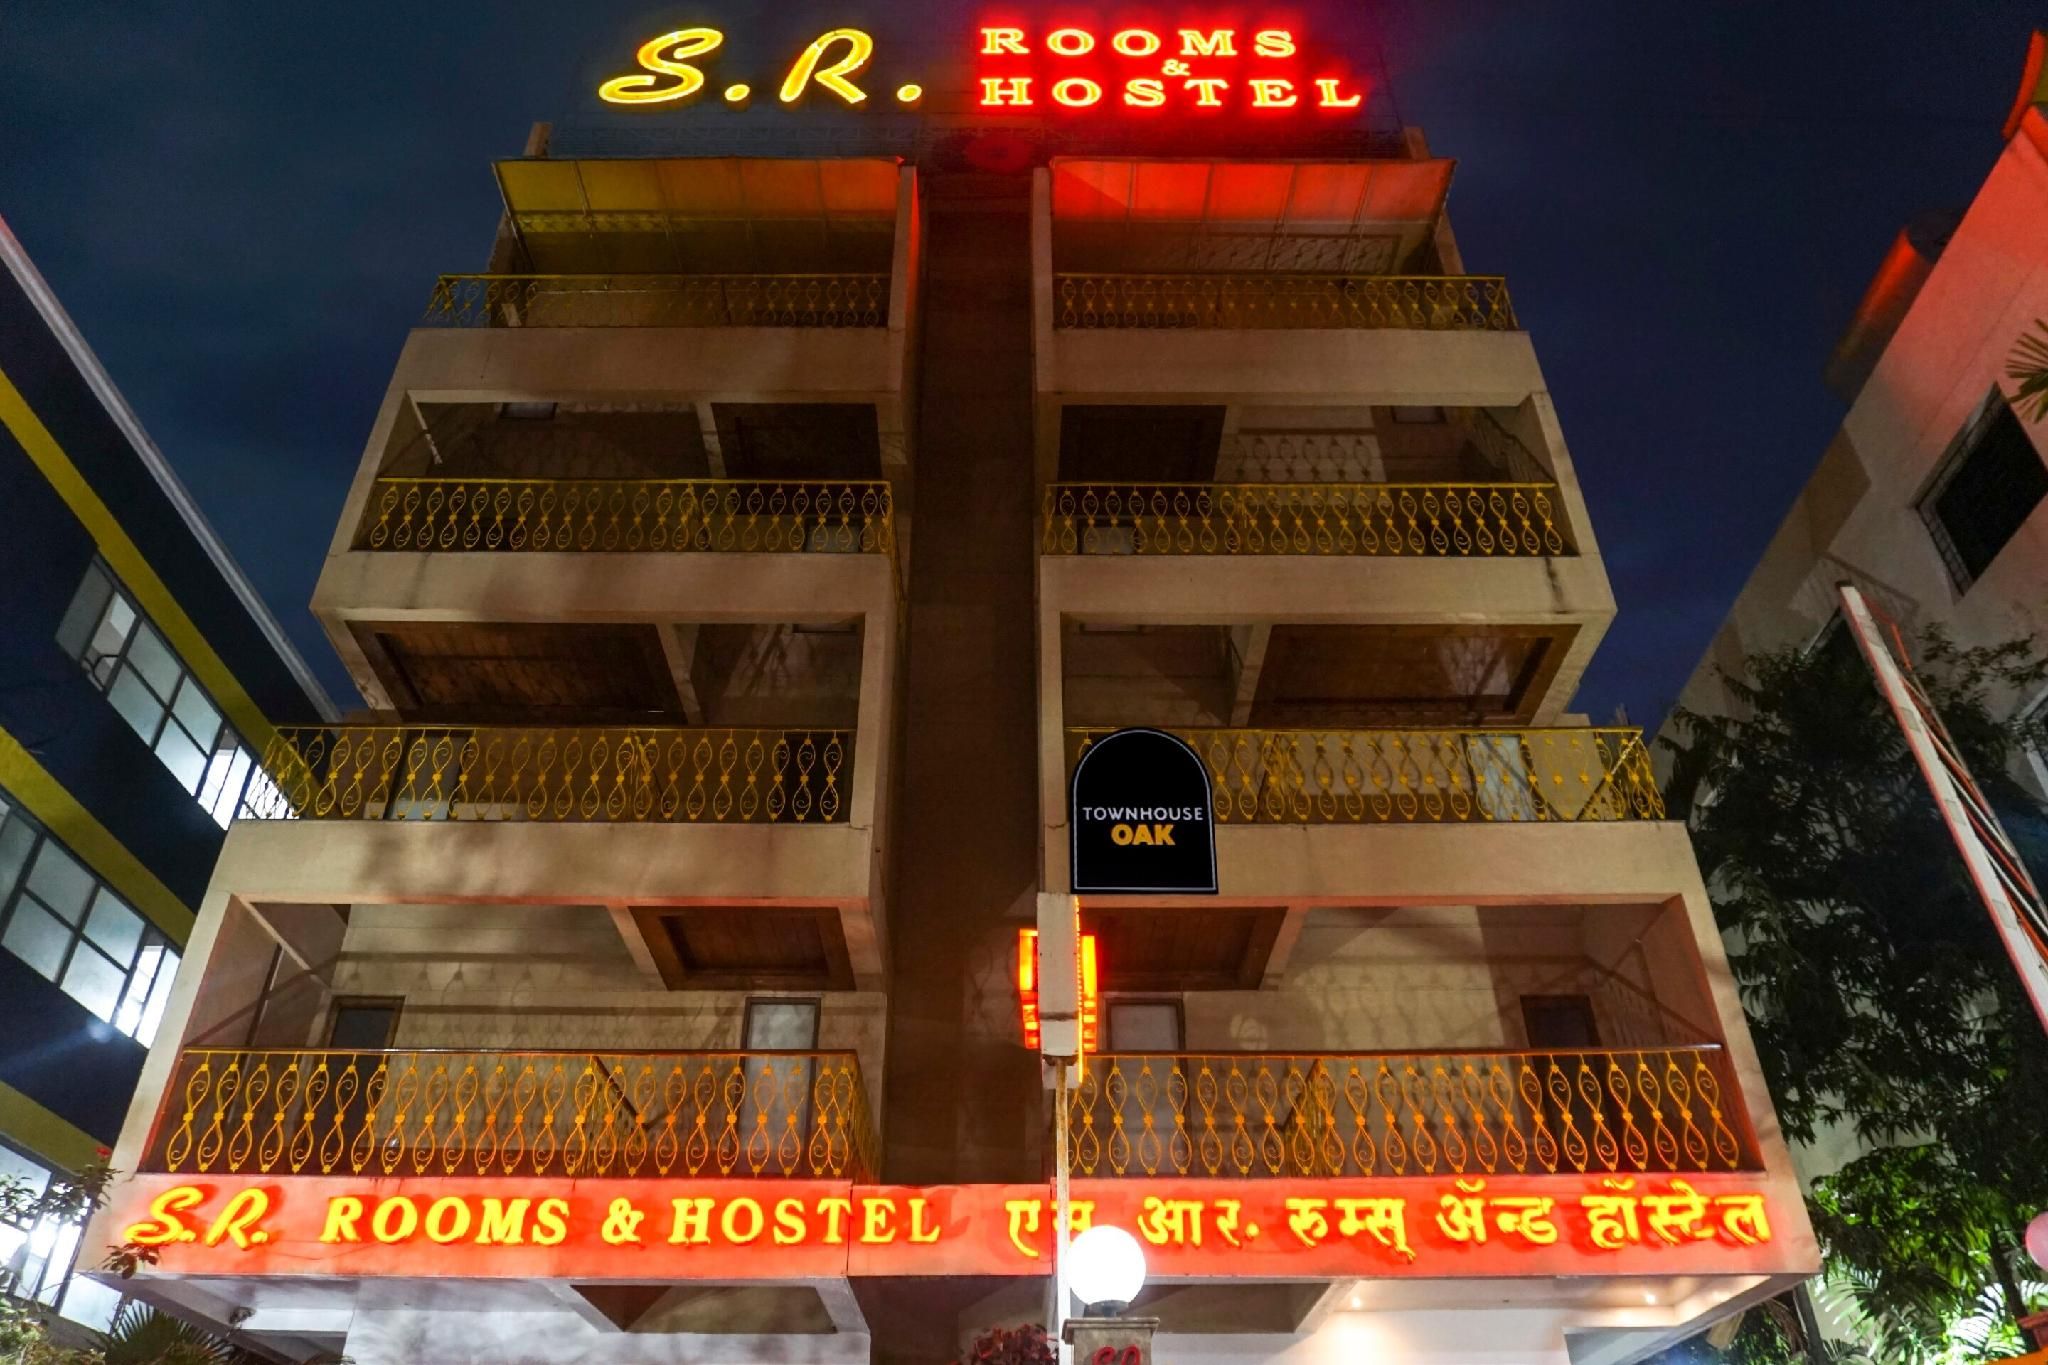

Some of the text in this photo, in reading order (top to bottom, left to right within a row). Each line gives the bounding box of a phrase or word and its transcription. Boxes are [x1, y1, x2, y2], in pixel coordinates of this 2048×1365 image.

[981, 27, 1296, 57] ROOMS
[1161, 58, 1191, 76] &
[980, 77, 1361, 107] HOSTEL
[1083, 807, 1203, 821] TOWNHOUSE
[1111, 823, 1175, 846] OAK
[321, 1196, 569, 1244] ROOMS
[601, 1197, 645, 1245] &
[667, 1197, 941, 1245] HOSTEL
